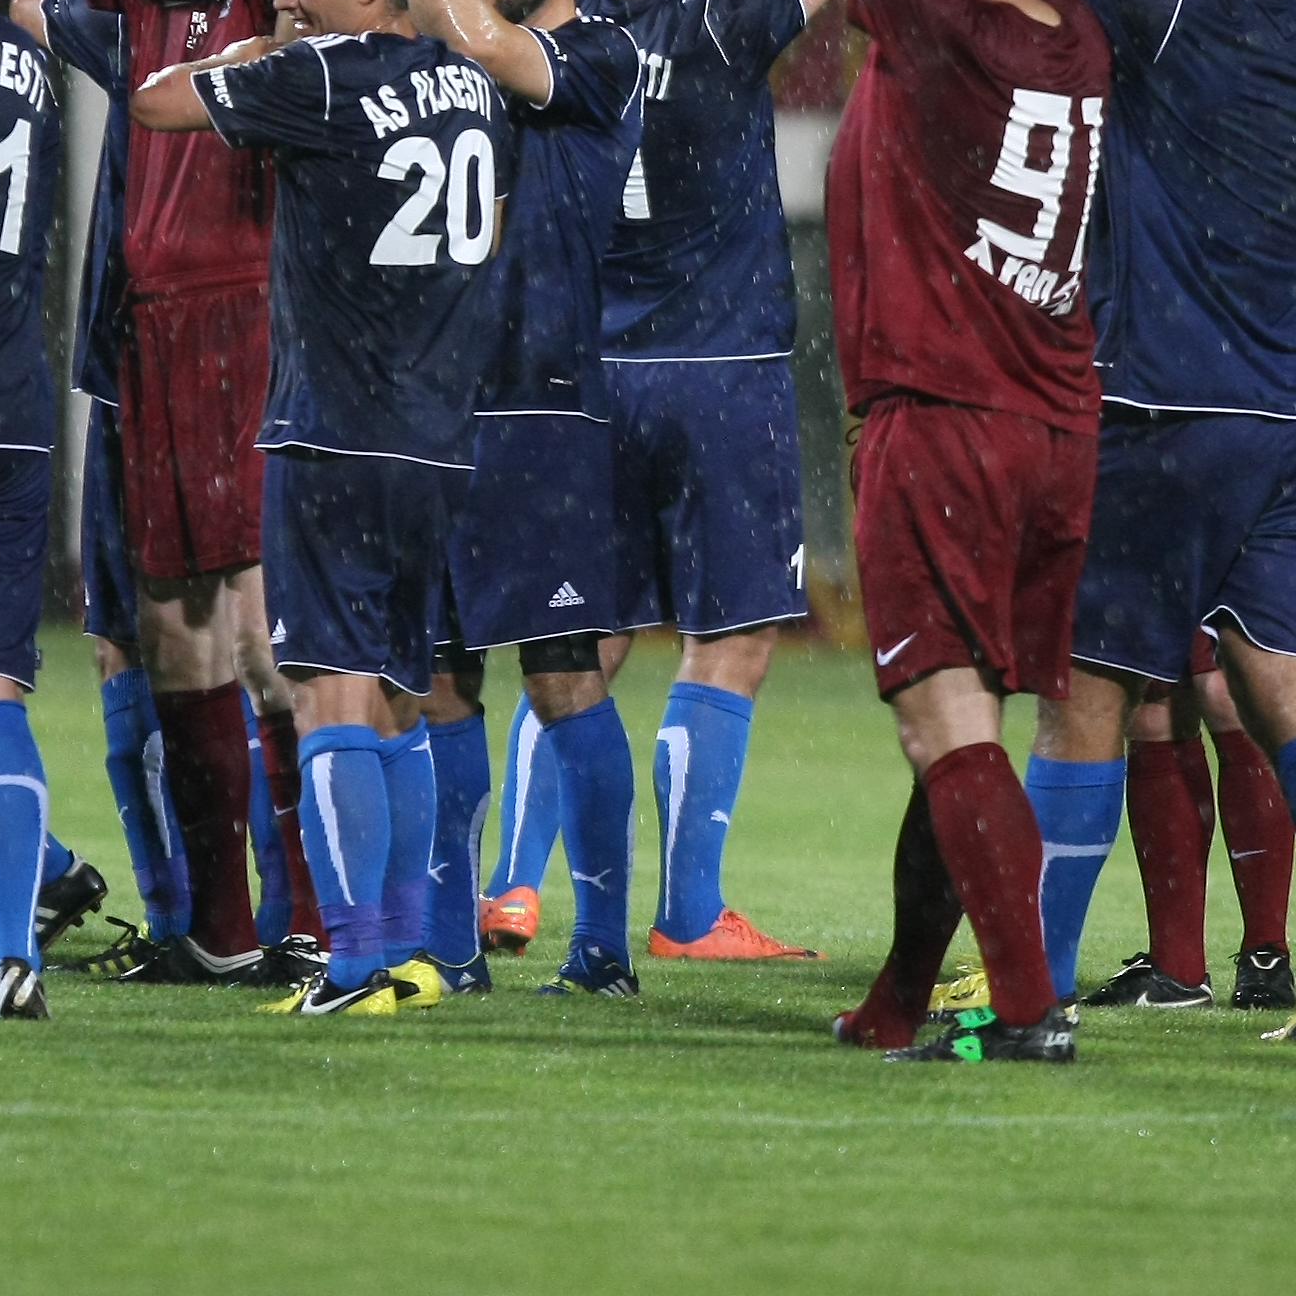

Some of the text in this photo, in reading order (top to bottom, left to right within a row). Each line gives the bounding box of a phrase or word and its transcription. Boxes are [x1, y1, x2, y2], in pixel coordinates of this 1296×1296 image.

[359, 84, 411, 140] AS
[369, 128, 496, 267] 20
[976, 88, 1104, 273] 91
[548, 595, 586, 608] adidas
